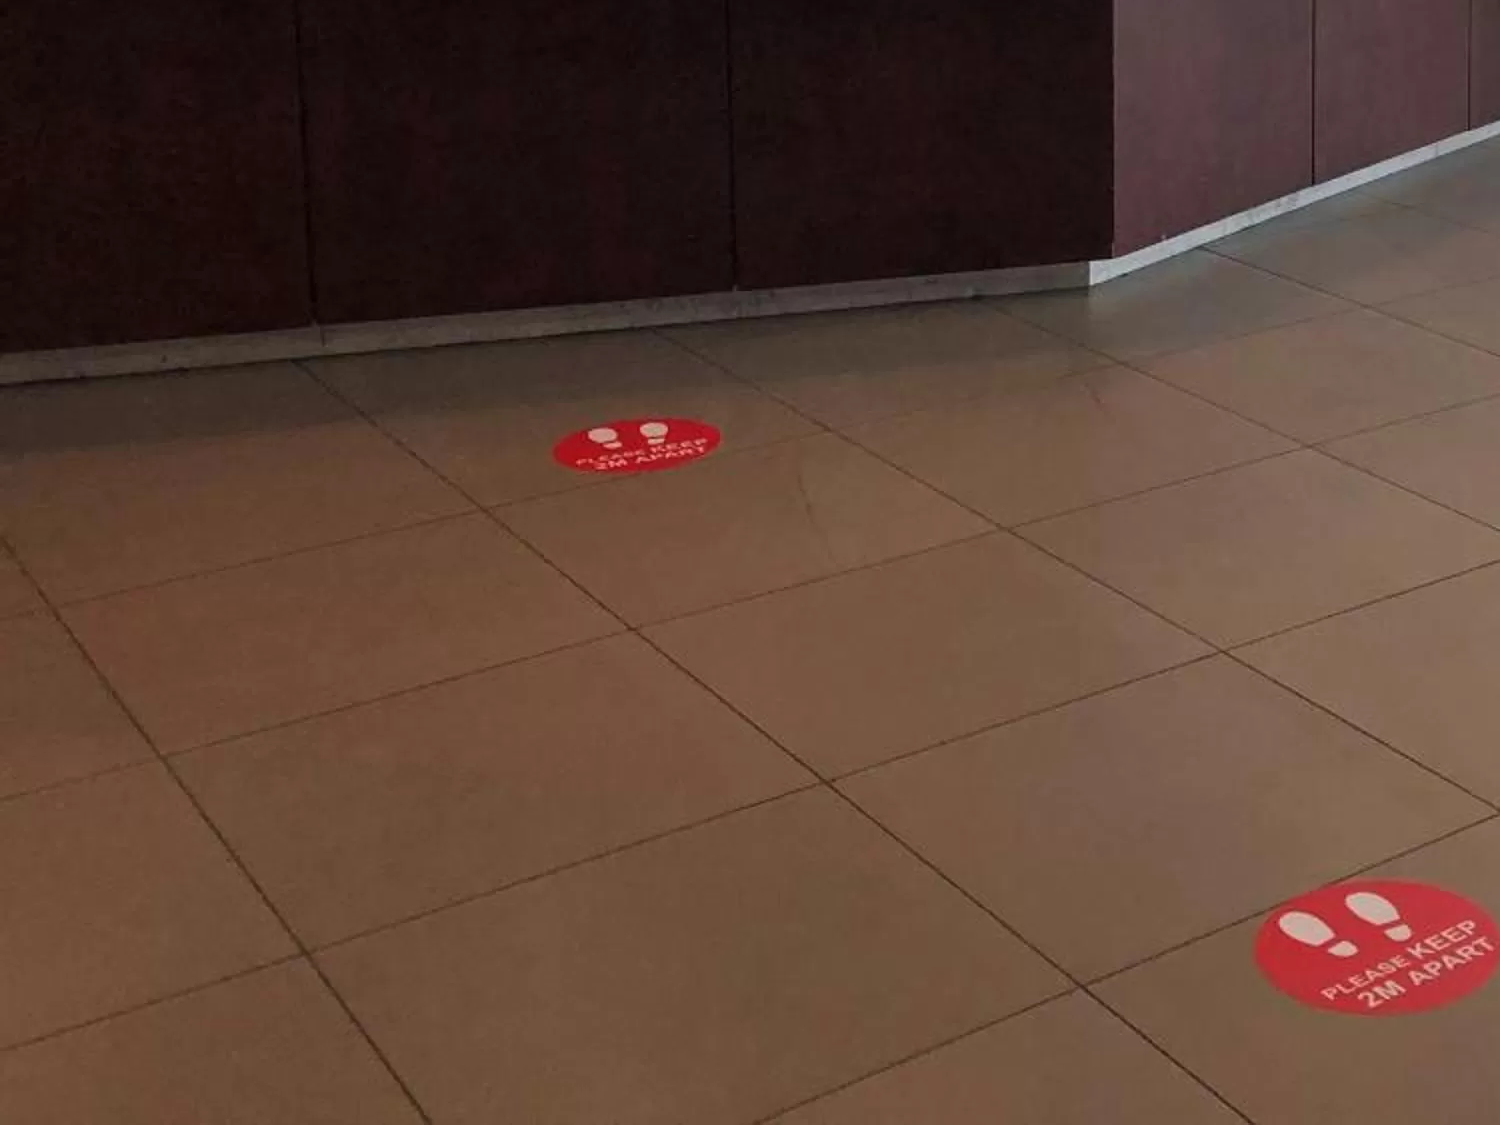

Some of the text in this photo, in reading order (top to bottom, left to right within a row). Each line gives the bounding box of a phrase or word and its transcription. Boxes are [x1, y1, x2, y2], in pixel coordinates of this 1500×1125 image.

[576, 438, 708, 466] PLEASE KEEP
[596, 446, 705, 470] 2M APART
[1320, 920, 1477, 1000] PLEASE KEEP
[1357, 936, 1495, 1008] 2M APART
